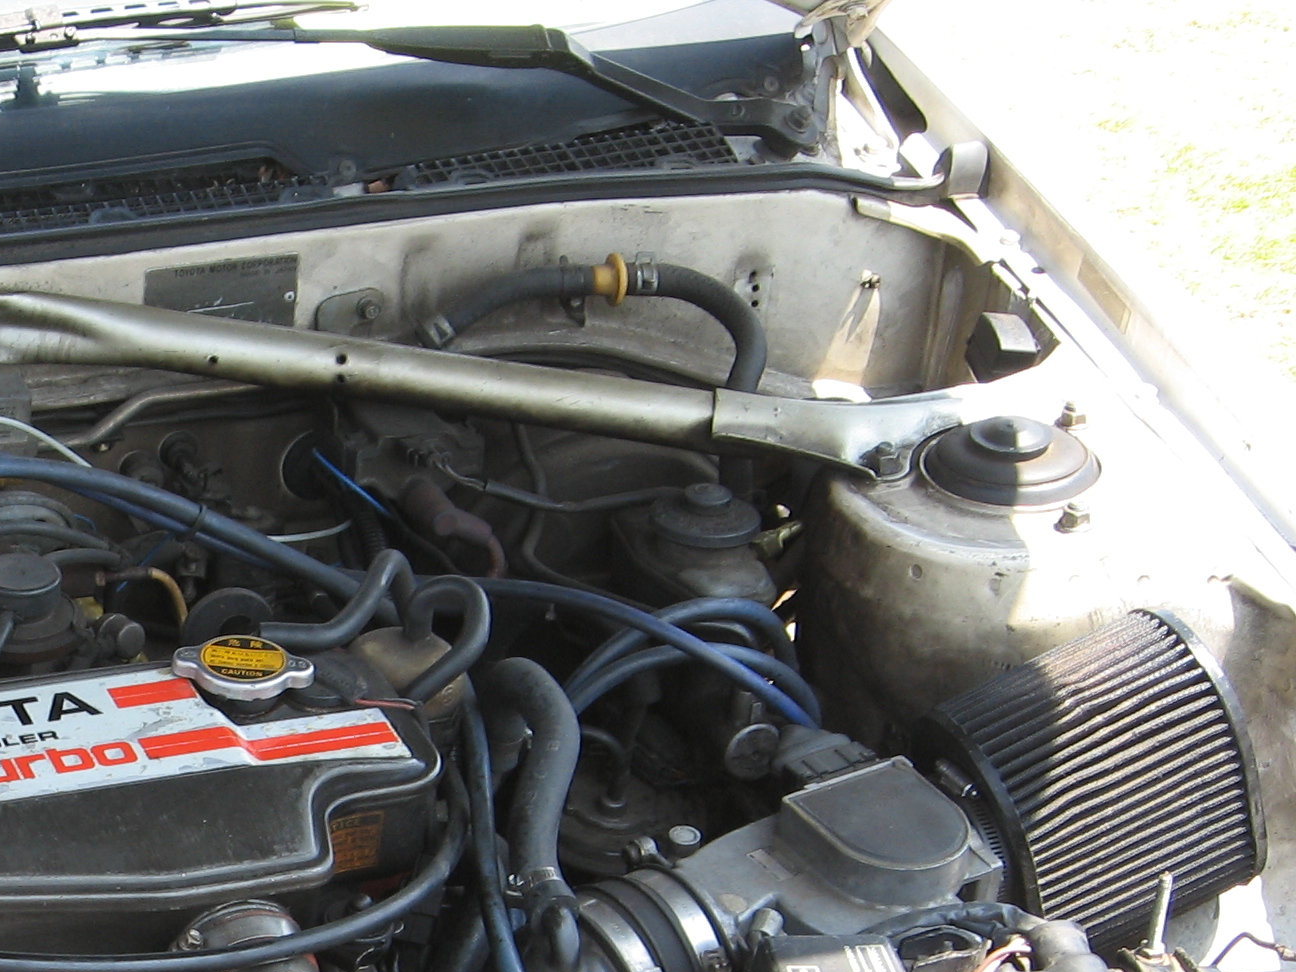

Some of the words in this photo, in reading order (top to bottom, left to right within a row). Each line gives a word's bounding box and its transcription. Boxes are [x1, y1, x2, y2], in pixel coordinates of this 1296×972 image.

[174, 269, 205, 278] TOYOTA
[209, 263, 238, 274] MOTOR
[221, 668, 263, 678] CAUTION
